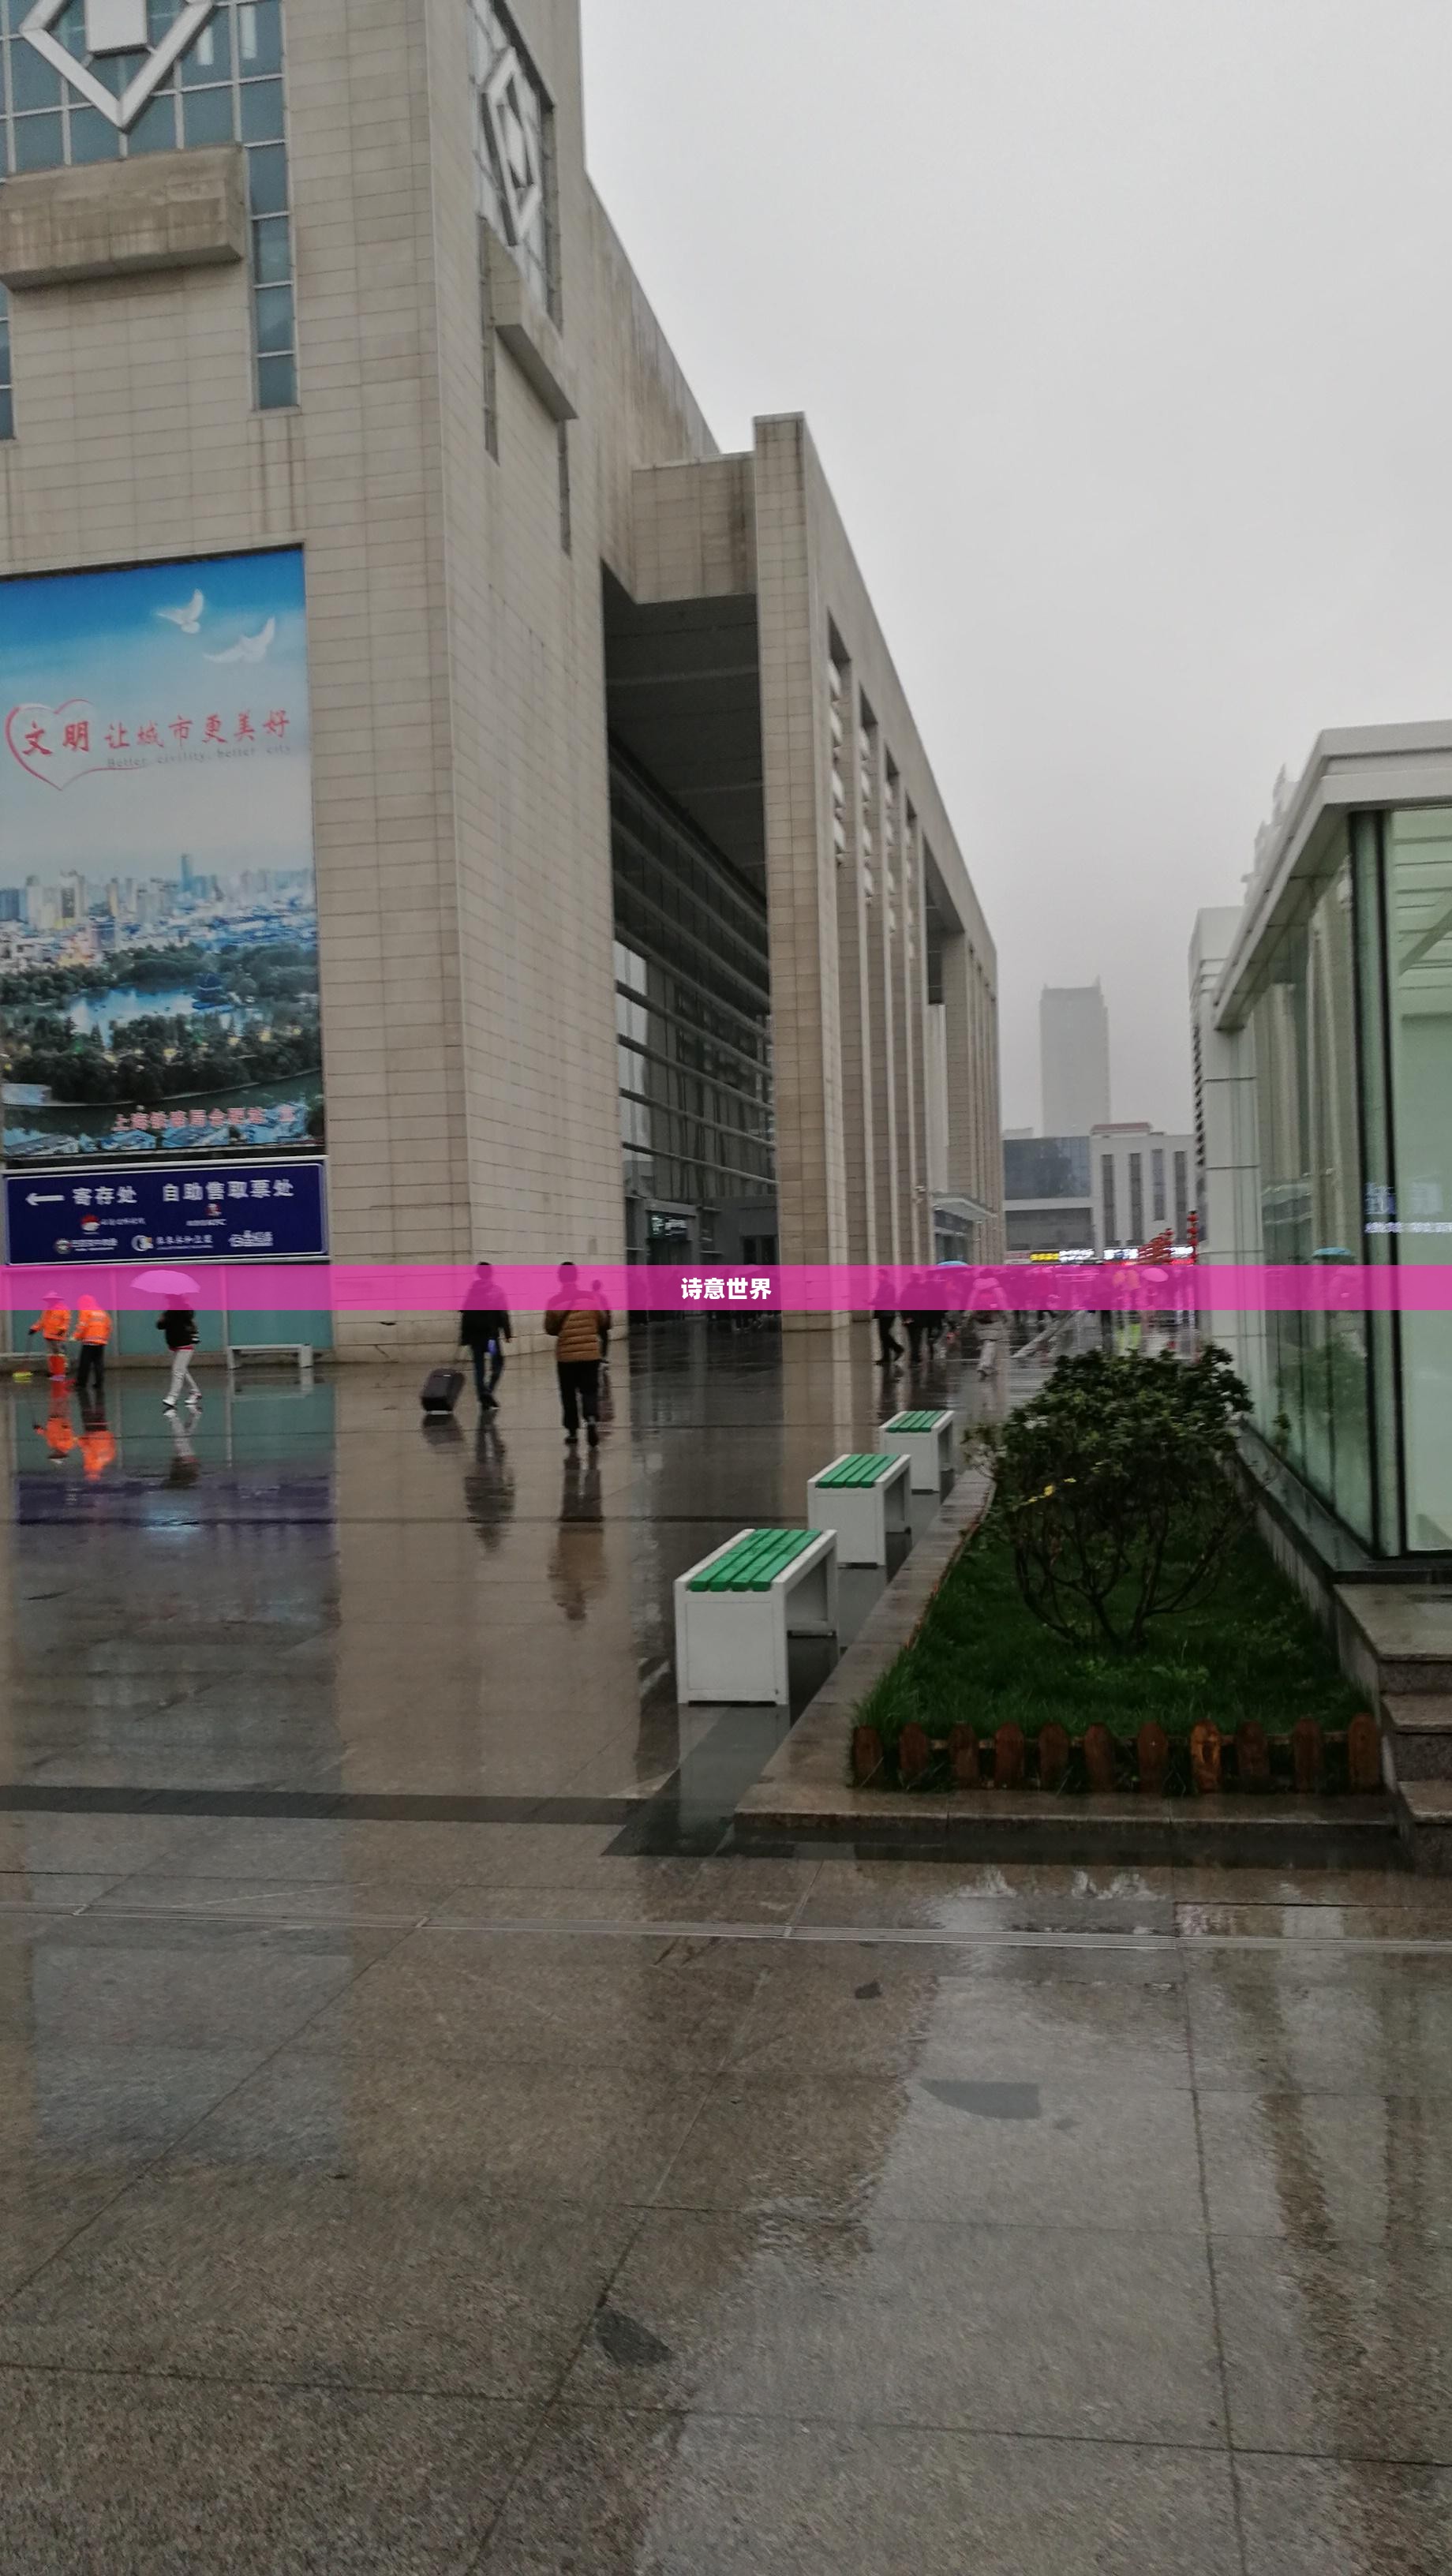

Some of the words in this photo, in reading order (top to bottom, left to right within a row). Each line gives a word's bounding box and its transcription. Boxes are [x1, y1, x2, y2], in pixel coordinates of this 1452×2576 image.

[72, 1185, 137, 1207] 寄存处
[162, 1178, 295, 1202] 自助售取票处
